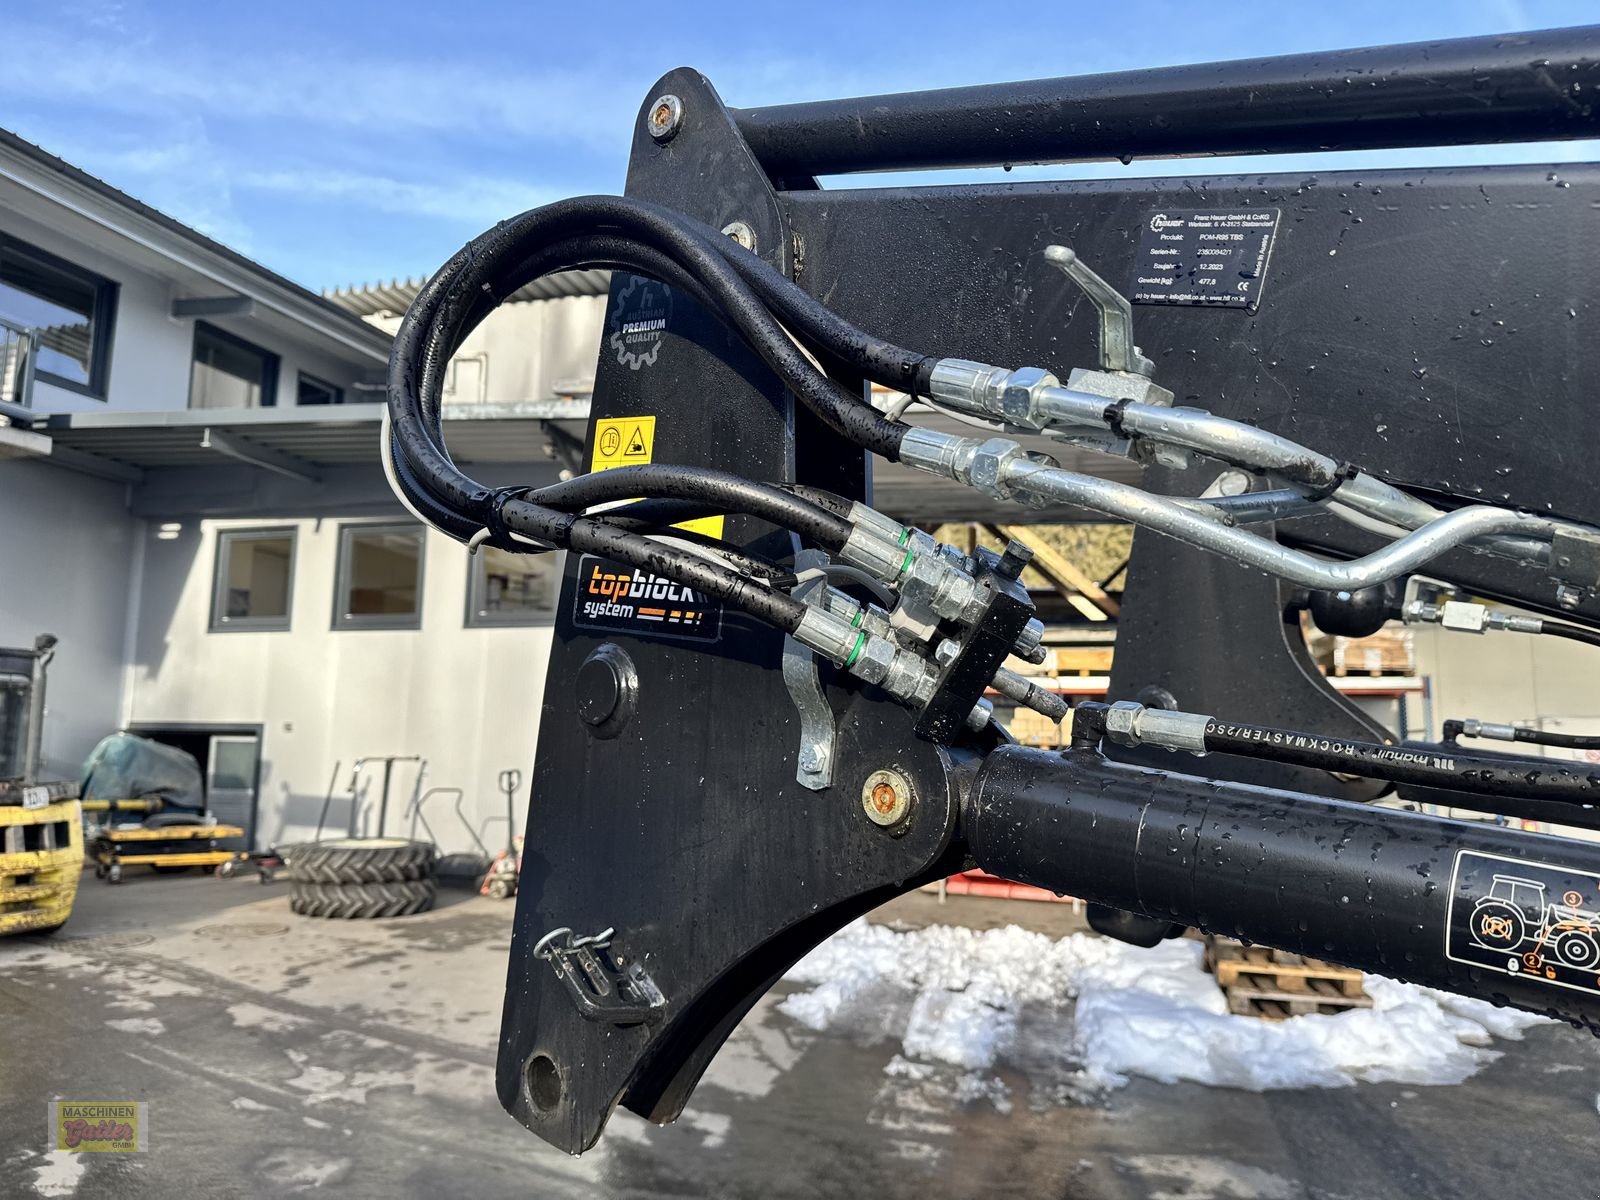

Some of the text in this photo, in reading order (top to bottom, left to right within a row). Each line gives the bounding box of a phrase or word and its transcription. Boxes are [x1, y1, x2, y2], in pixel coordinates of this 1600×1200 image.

[1137, 277, 1160, 285] Gewicht
[1198, 278, 1217, 286] 477,8
[622, 318, 666, 334] PREMIUM
[625, 331, 661, 344] QUALITY
[583, 599, 634, 619] system
